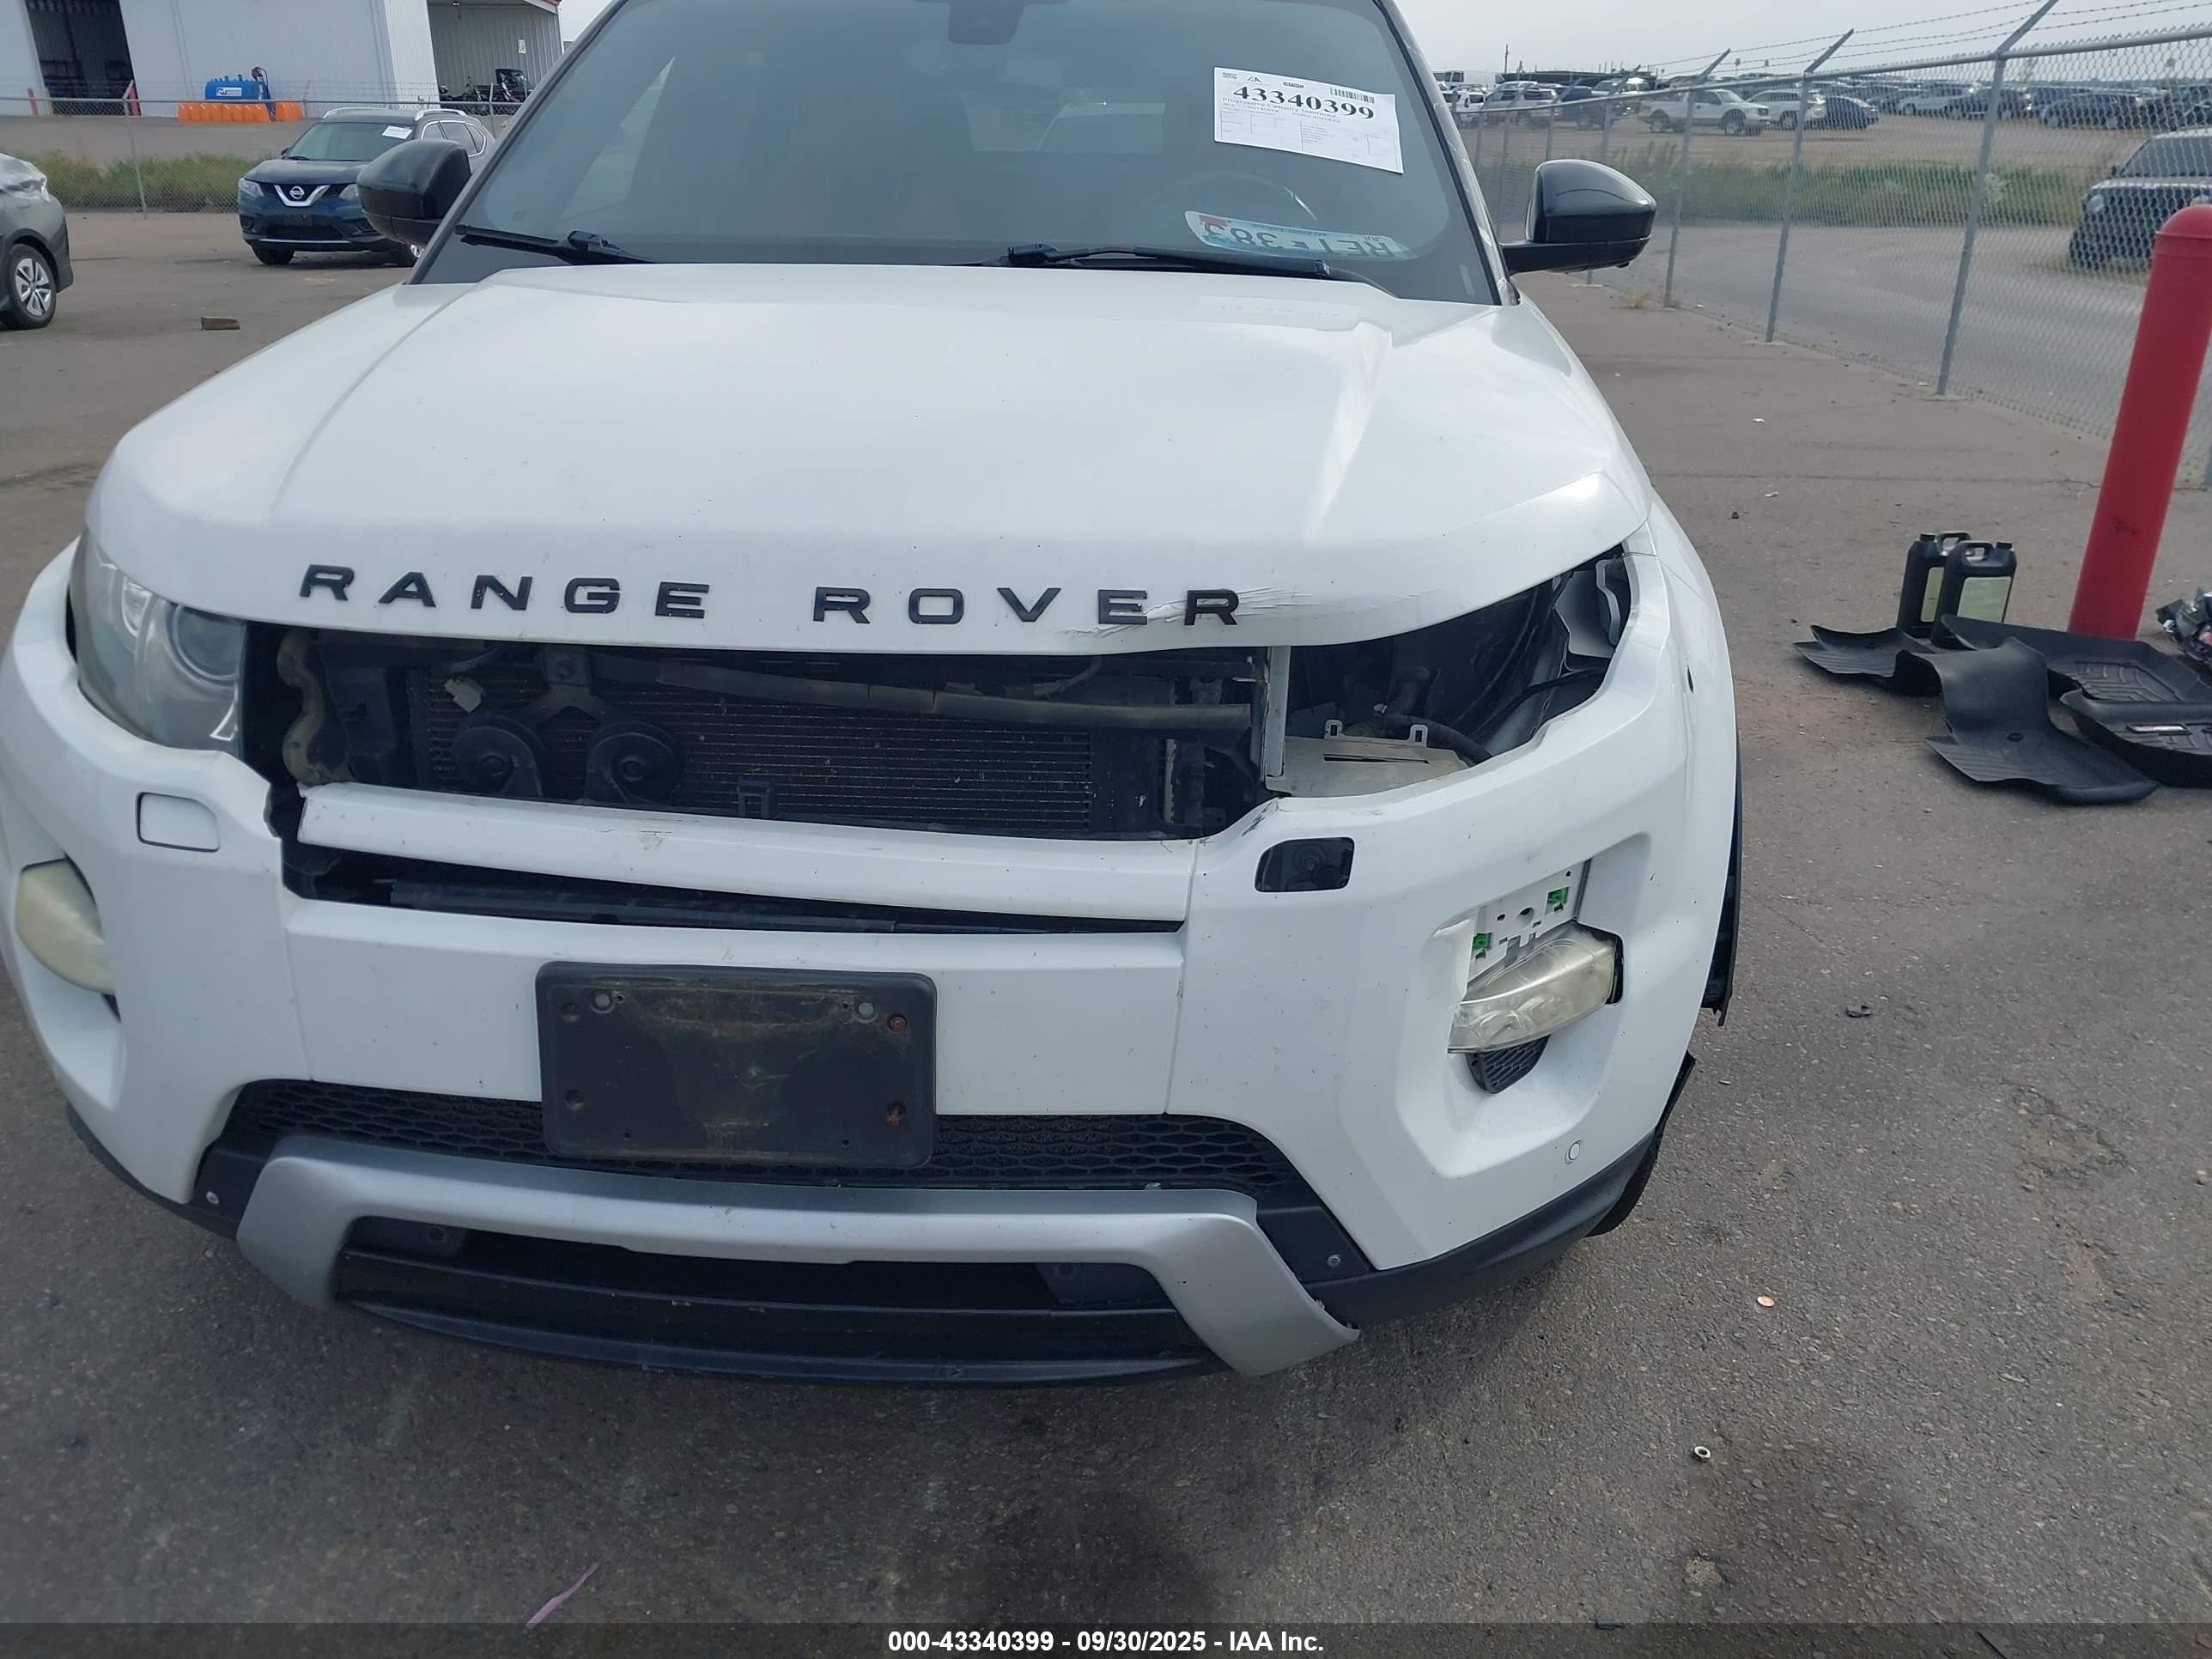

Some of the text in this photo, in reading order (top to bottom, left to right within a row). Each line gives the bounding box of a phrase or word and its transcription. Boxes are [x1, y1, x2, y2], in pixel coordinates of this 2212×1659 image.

[1223, 97, 1266, 106] Progressive
[1233, 86, 1375, 119] 43340399
[299, 564, 1239, 626] RANGE ROVER
